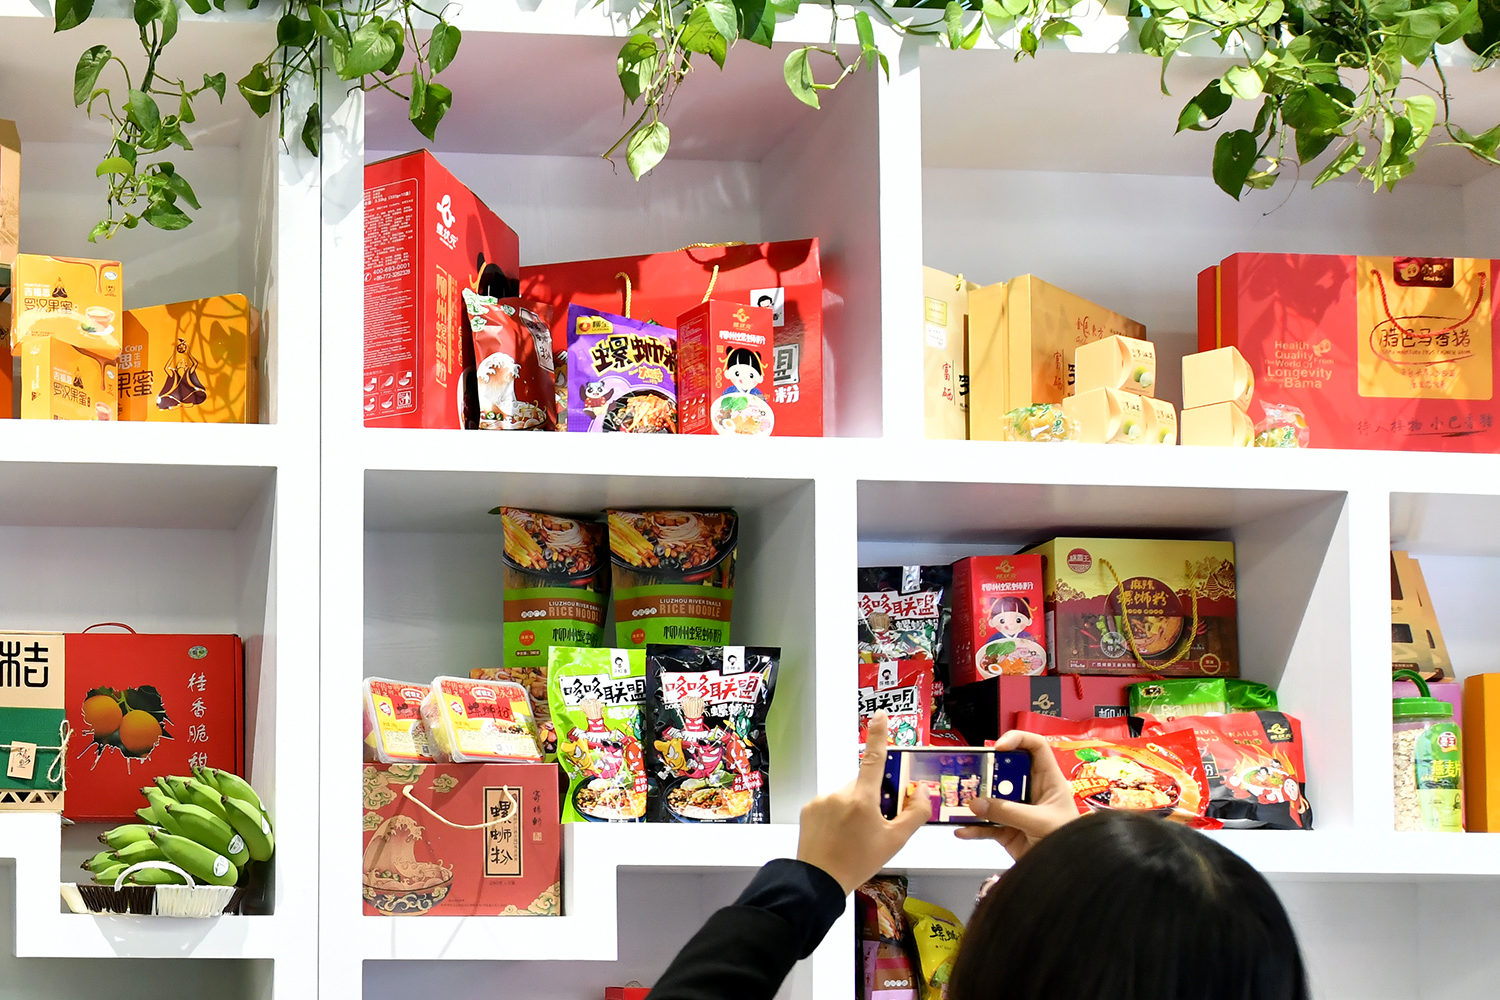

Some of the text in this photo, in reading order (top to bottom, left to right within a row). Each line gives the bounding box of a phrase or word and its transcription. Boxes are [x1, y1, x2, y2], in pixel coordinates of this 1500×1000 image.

[23, 286, 51, 298] 吉福思
[718, 329, 767, 346] 柳州螺蛳粉
[1379, 327, 1472, 349] 腊巴马香猪
[124, 343, 143, 354] Corp
[1274, 340, 1310, 351] Health
[1274, 350, 1315, 361] Quality
[1275, 359, 1303, 369] World
[1313, 357, 1335, 365] From
[53, 370, 73, 385] 吉福思
[1266, 365, 1334, 381] Longevity
[1283, 376, 1323, 390] Bama
[981, 581, 1034, 593] 柳州螺蛳粉
[548, 600, 577, 608] LIUZHOU
[659, 597, 722, 608] LIUZHOU RIVER SNAILS
[548, 605, 573, 618] RICE
[659, 602, 721, 619] RICE NOODLE
[662, 624, 723, 644] 柳州螺蛳粉
[563, 676, 647, 703] 哆哆联盟
[664, 674, 760, 699] 哆哆联盟
[489, 800, 514, 866] 螺蛳粉
